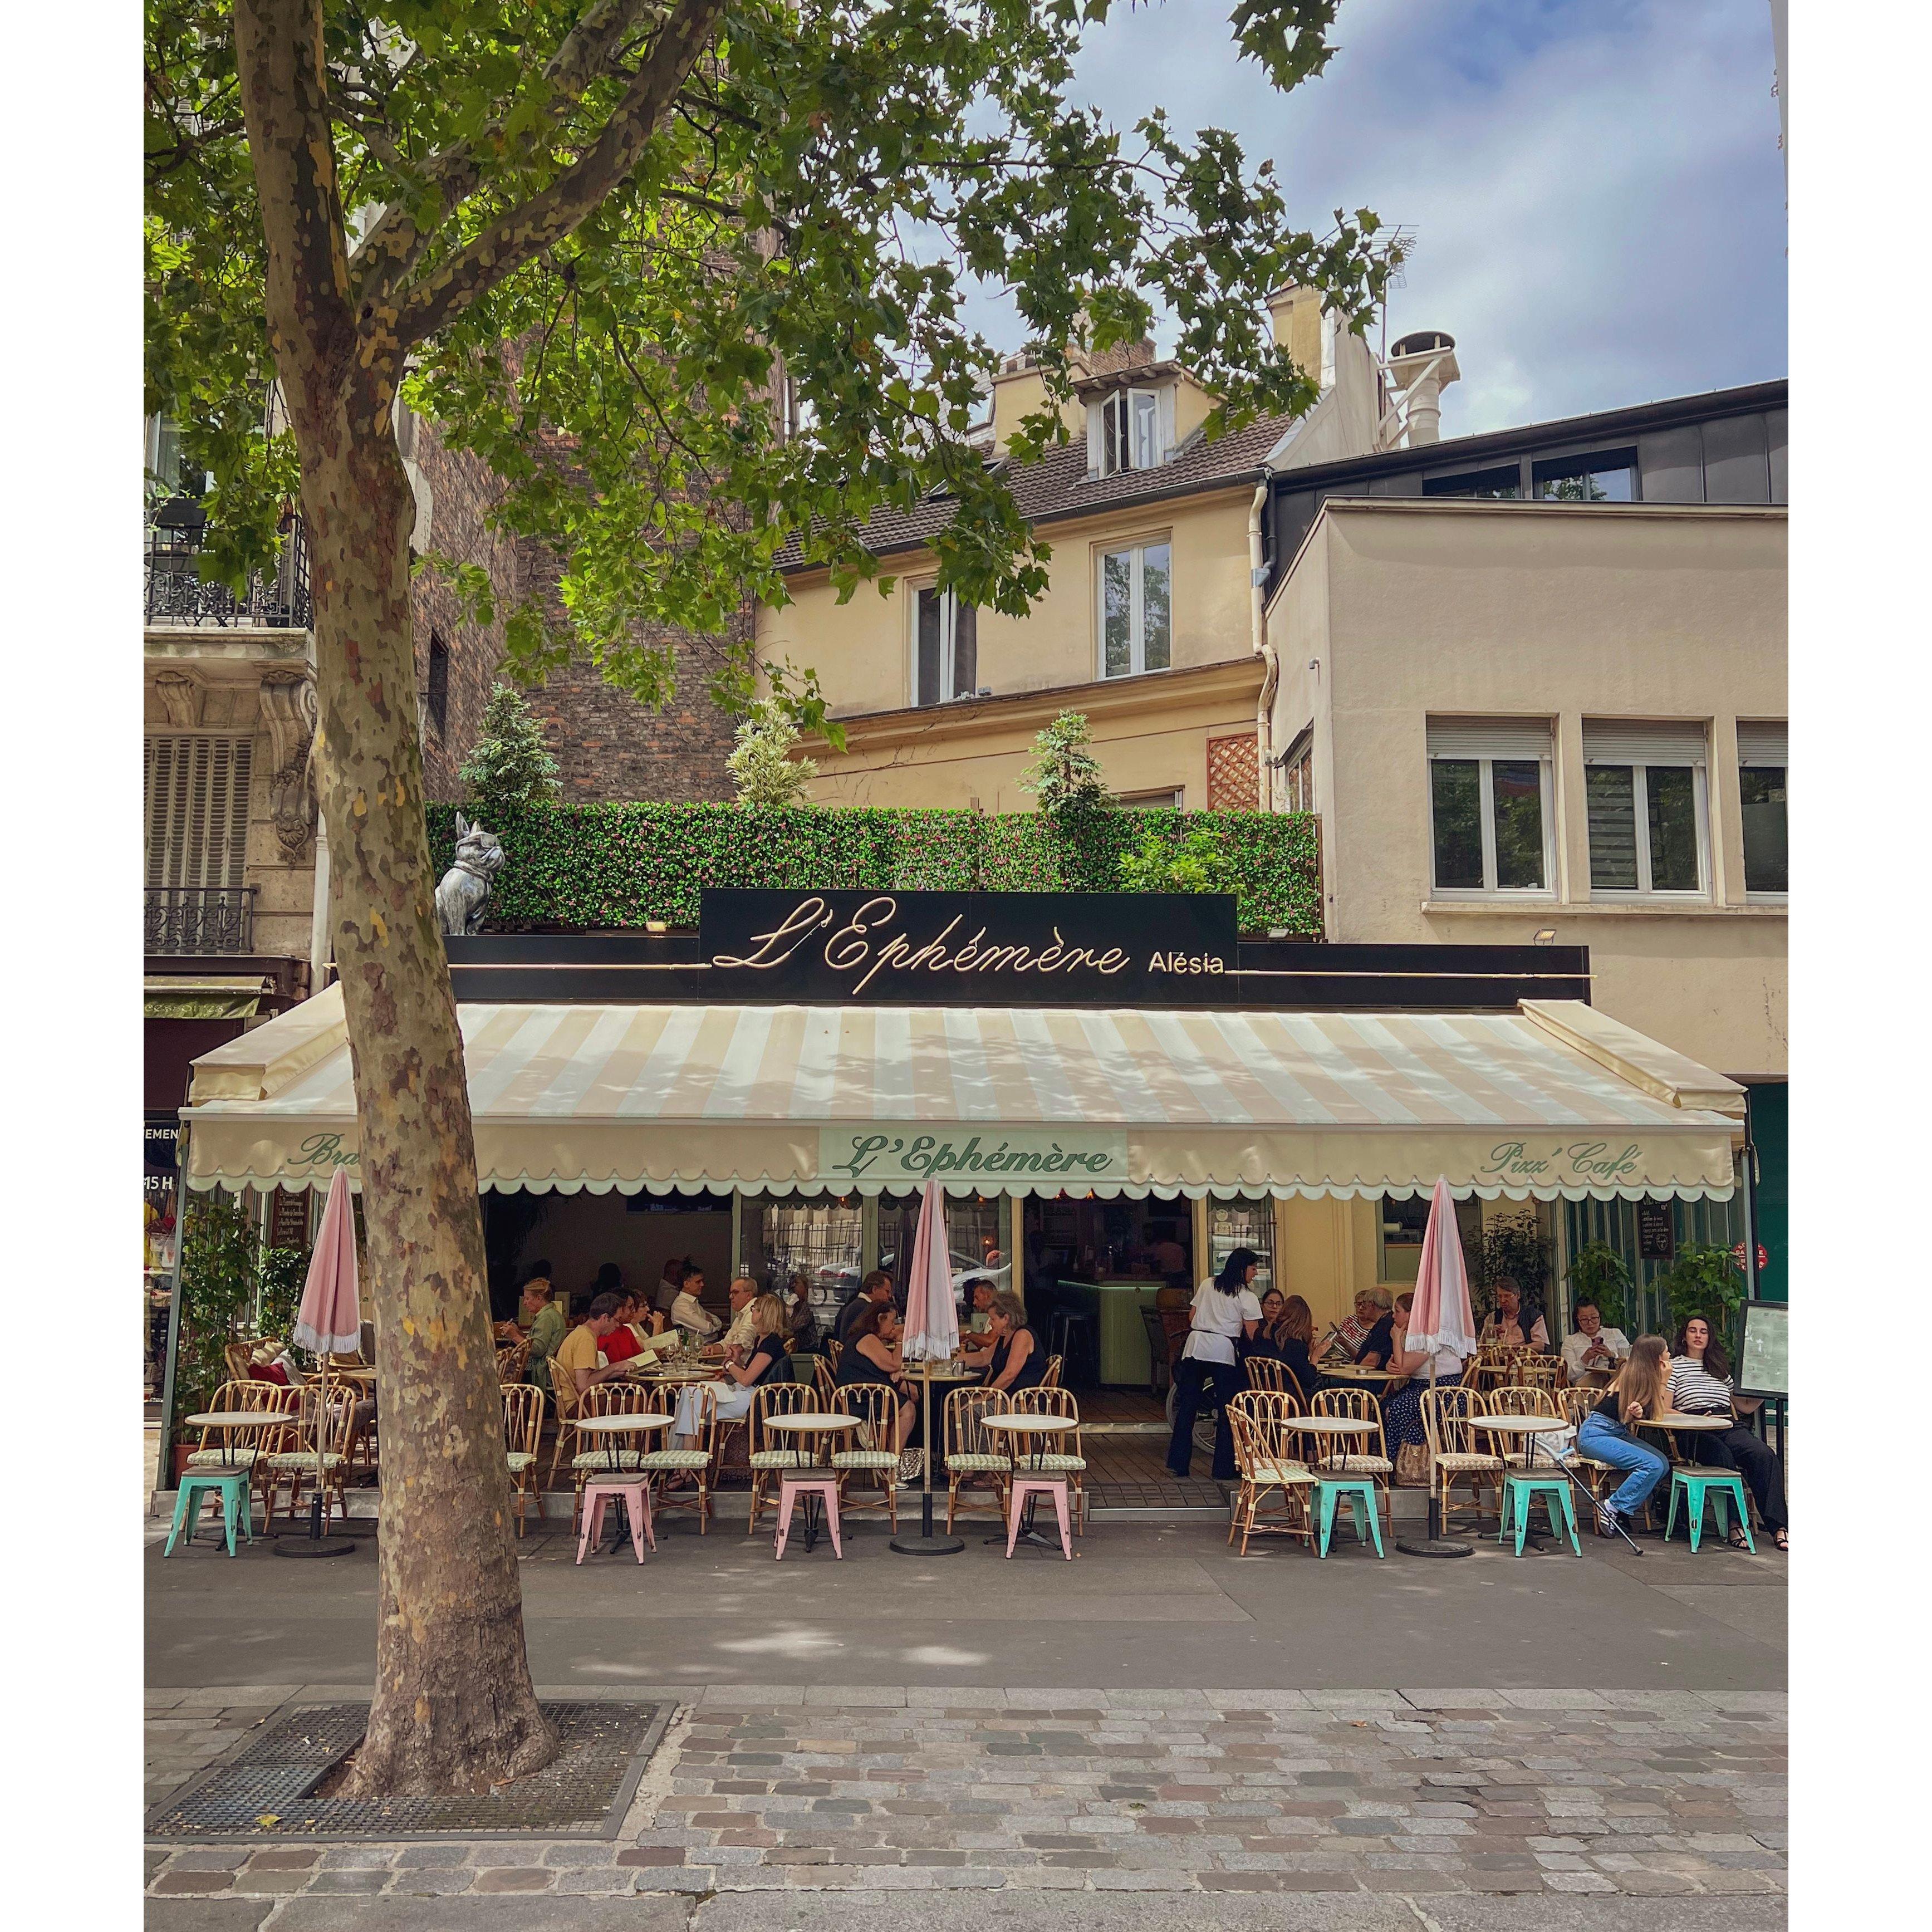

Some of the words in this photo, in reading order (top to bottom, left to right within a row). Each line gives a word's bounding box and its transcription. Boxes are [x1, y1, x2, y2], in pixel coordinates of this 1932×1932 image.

[713, 896, 1130, 995] L'Ephémère
[1148, 951, 1225, 974] Alésia
[144, 1129, 178, 1139] EMEN
[832, 1135, 1113, 1178] L'Ephémère
[1567, 1142, 1644, 1180] Café
